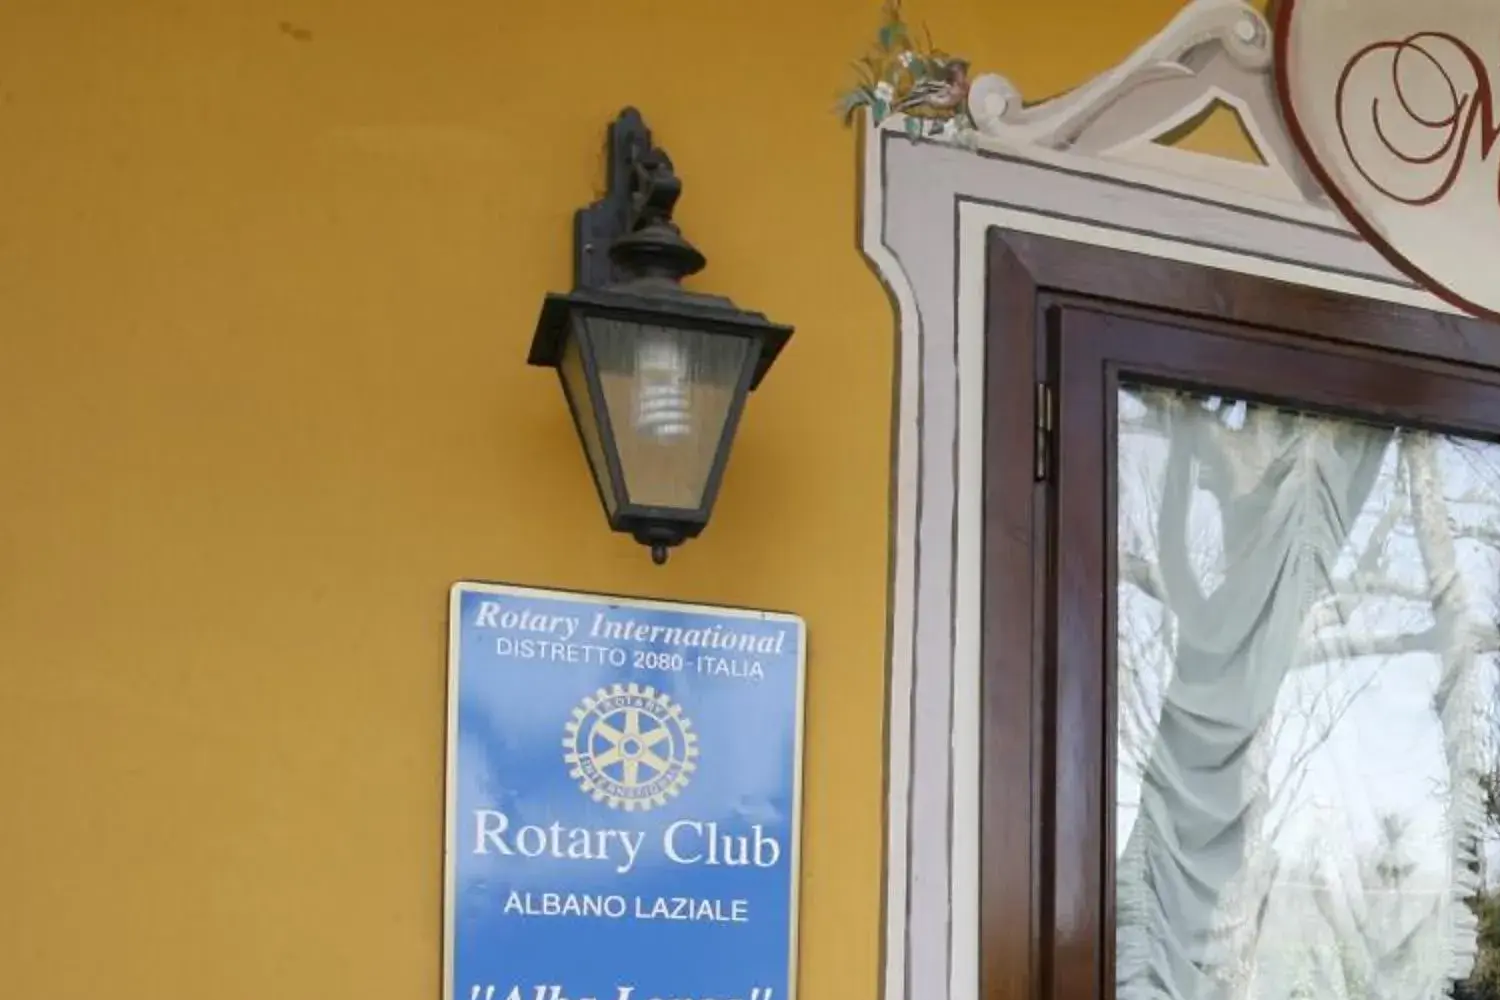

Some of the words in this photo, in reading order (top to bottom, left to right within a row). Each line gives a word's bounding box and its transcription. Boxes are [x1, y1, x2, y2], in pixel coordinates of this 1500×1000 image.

[475, 601, 580, 640] Rotary
[590, 612, 787, 655] International
[496, 637, 626, 667] DISTRETTO
[471, 808, 647, 874] Rotary
[663, 819, 780, 867] Club
[504, 890, 627, 918] ALBANO
[635, 896, 750, 922] LAZIALE
